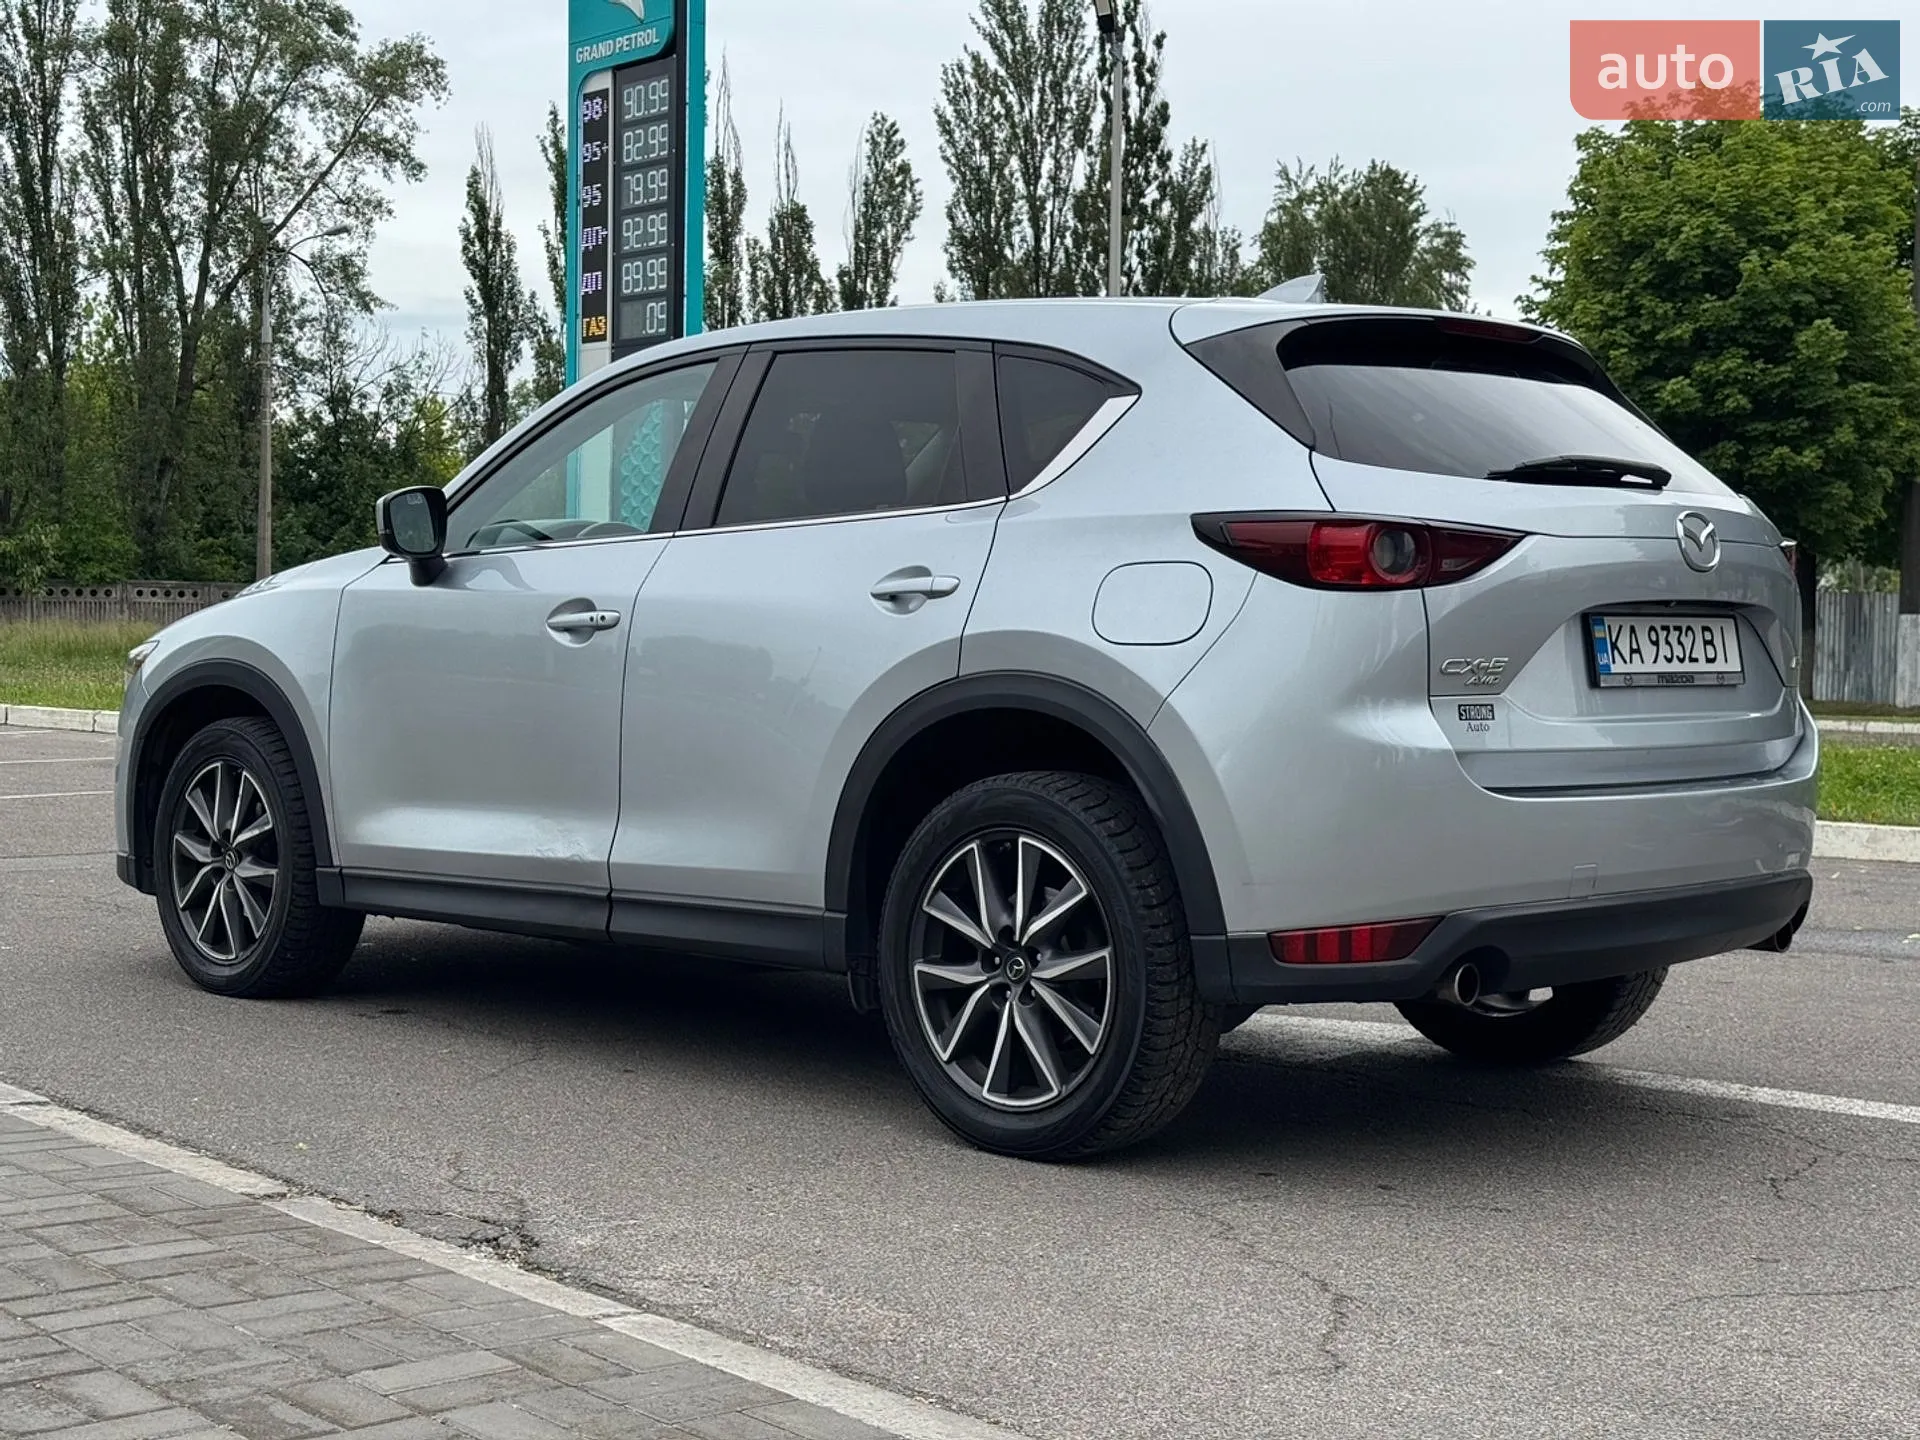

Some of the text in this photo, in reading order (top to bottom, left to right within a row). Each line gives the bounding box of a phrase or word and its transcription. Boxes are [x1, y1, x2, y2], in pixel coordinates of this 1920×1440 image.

[576, 27, 660, 63] GRAND PETROL
[624, 79, 669, 119] 90.99
[583, 124, 668, 163] 95+ 82.99
[582, 169, 668, 208] 95 79.99
[622, 212, 668, 250] 92.99
[581, 257, 667, 295] ДП 89.99
[582, 316, 607, 337] ГАЗ
[1598, 653, 1609, 664] UA
[1608, 624, 1728, 664] KA 9332 BI
[1441, 657, 1508, 674] CX-5
[1460, 705, 1493, 719] STRONG
[1466, 722, 1490, 732] Auto
